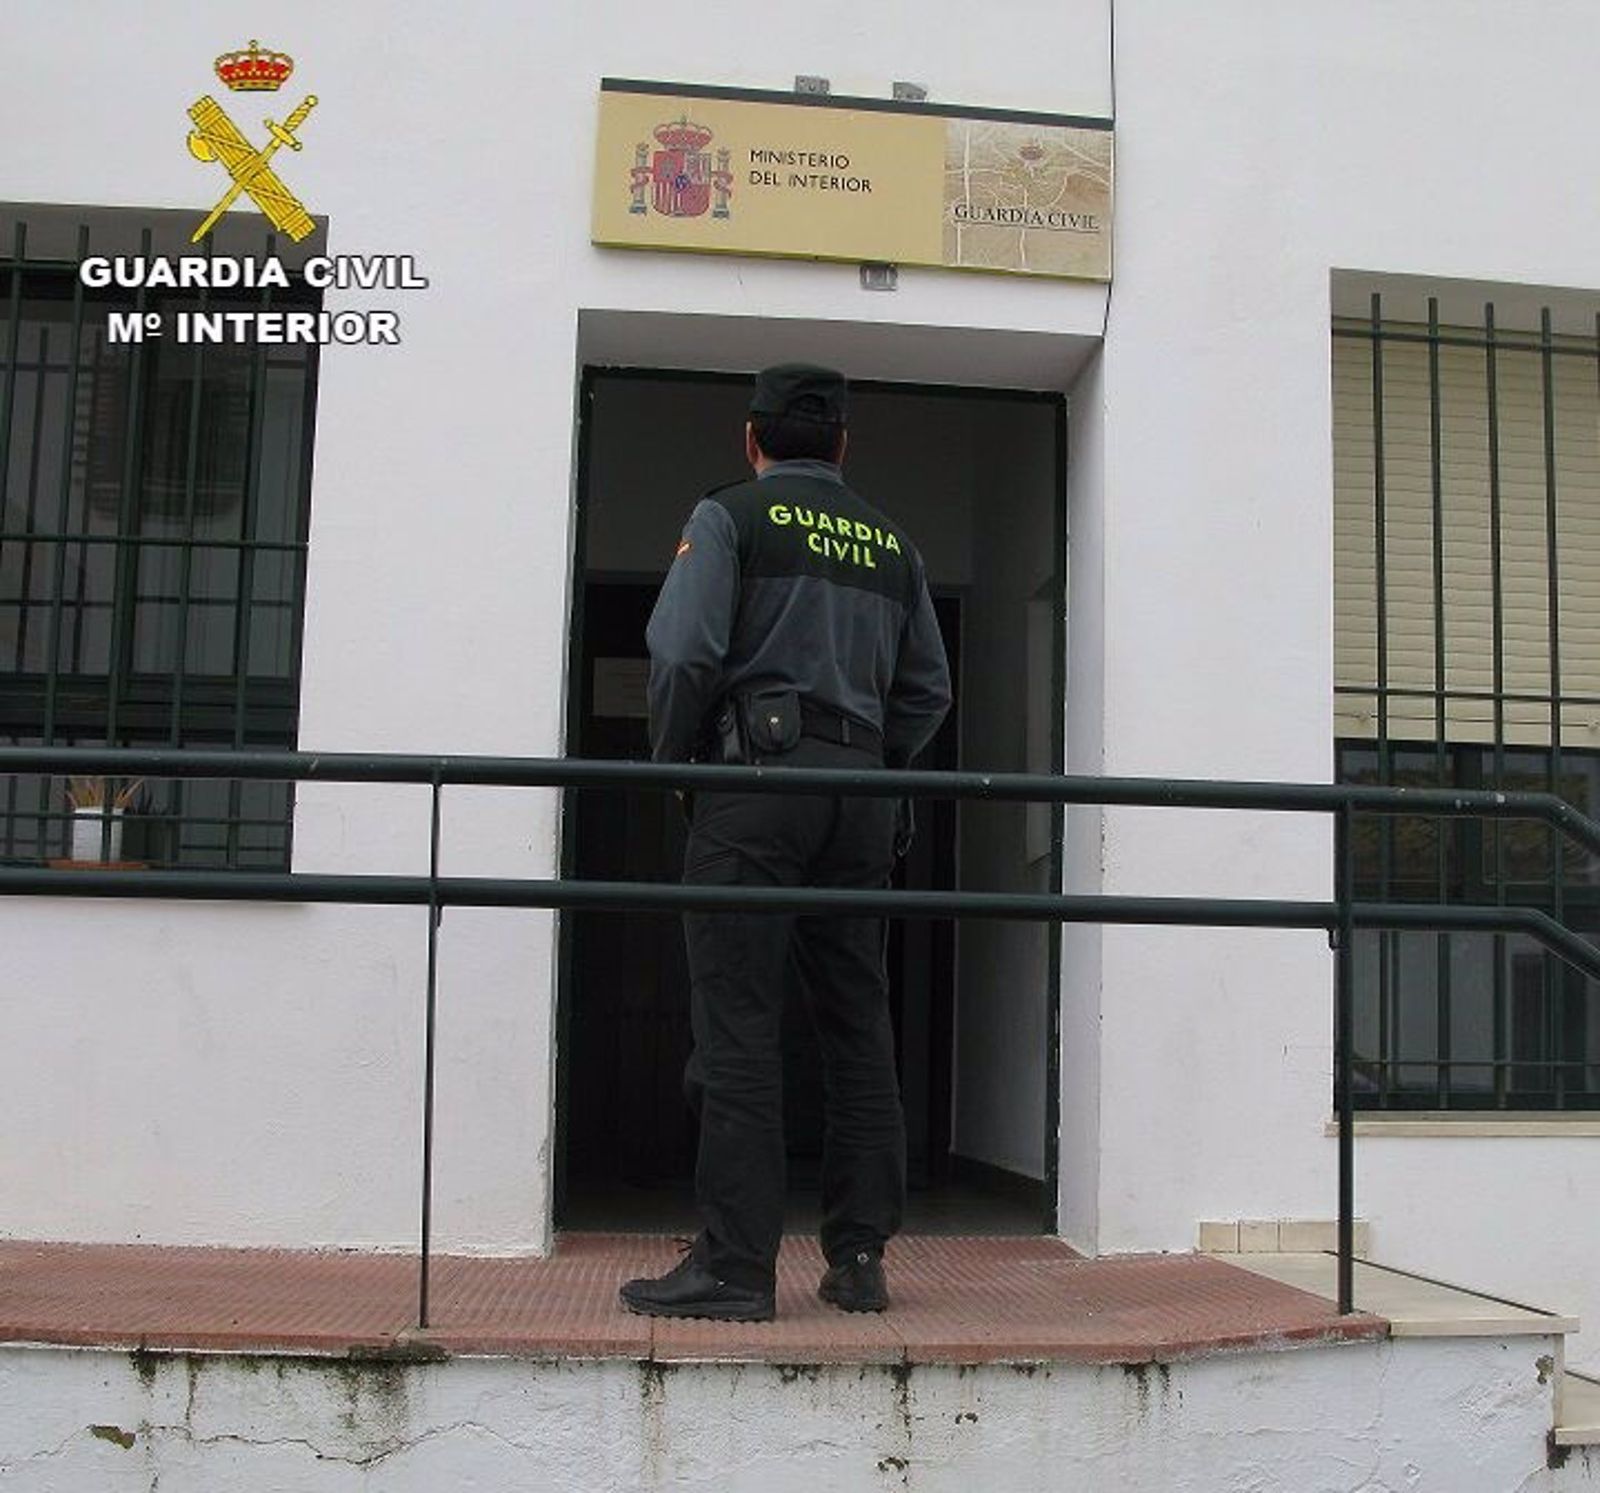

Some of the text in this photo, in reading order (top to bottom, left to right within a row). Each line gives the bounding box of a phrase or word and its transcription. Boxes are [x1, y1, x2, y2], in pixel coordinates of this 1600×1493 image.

[750, 150, 850, 169] MINISTERIO
[749, 170, 872, 192] DEL INTERIOR
[954, 204, 1099, 229] GUARDIA CIVIL
[768, 504, 901, 555] GUARDIA
[807, 532, 877, 568] CIVIL
